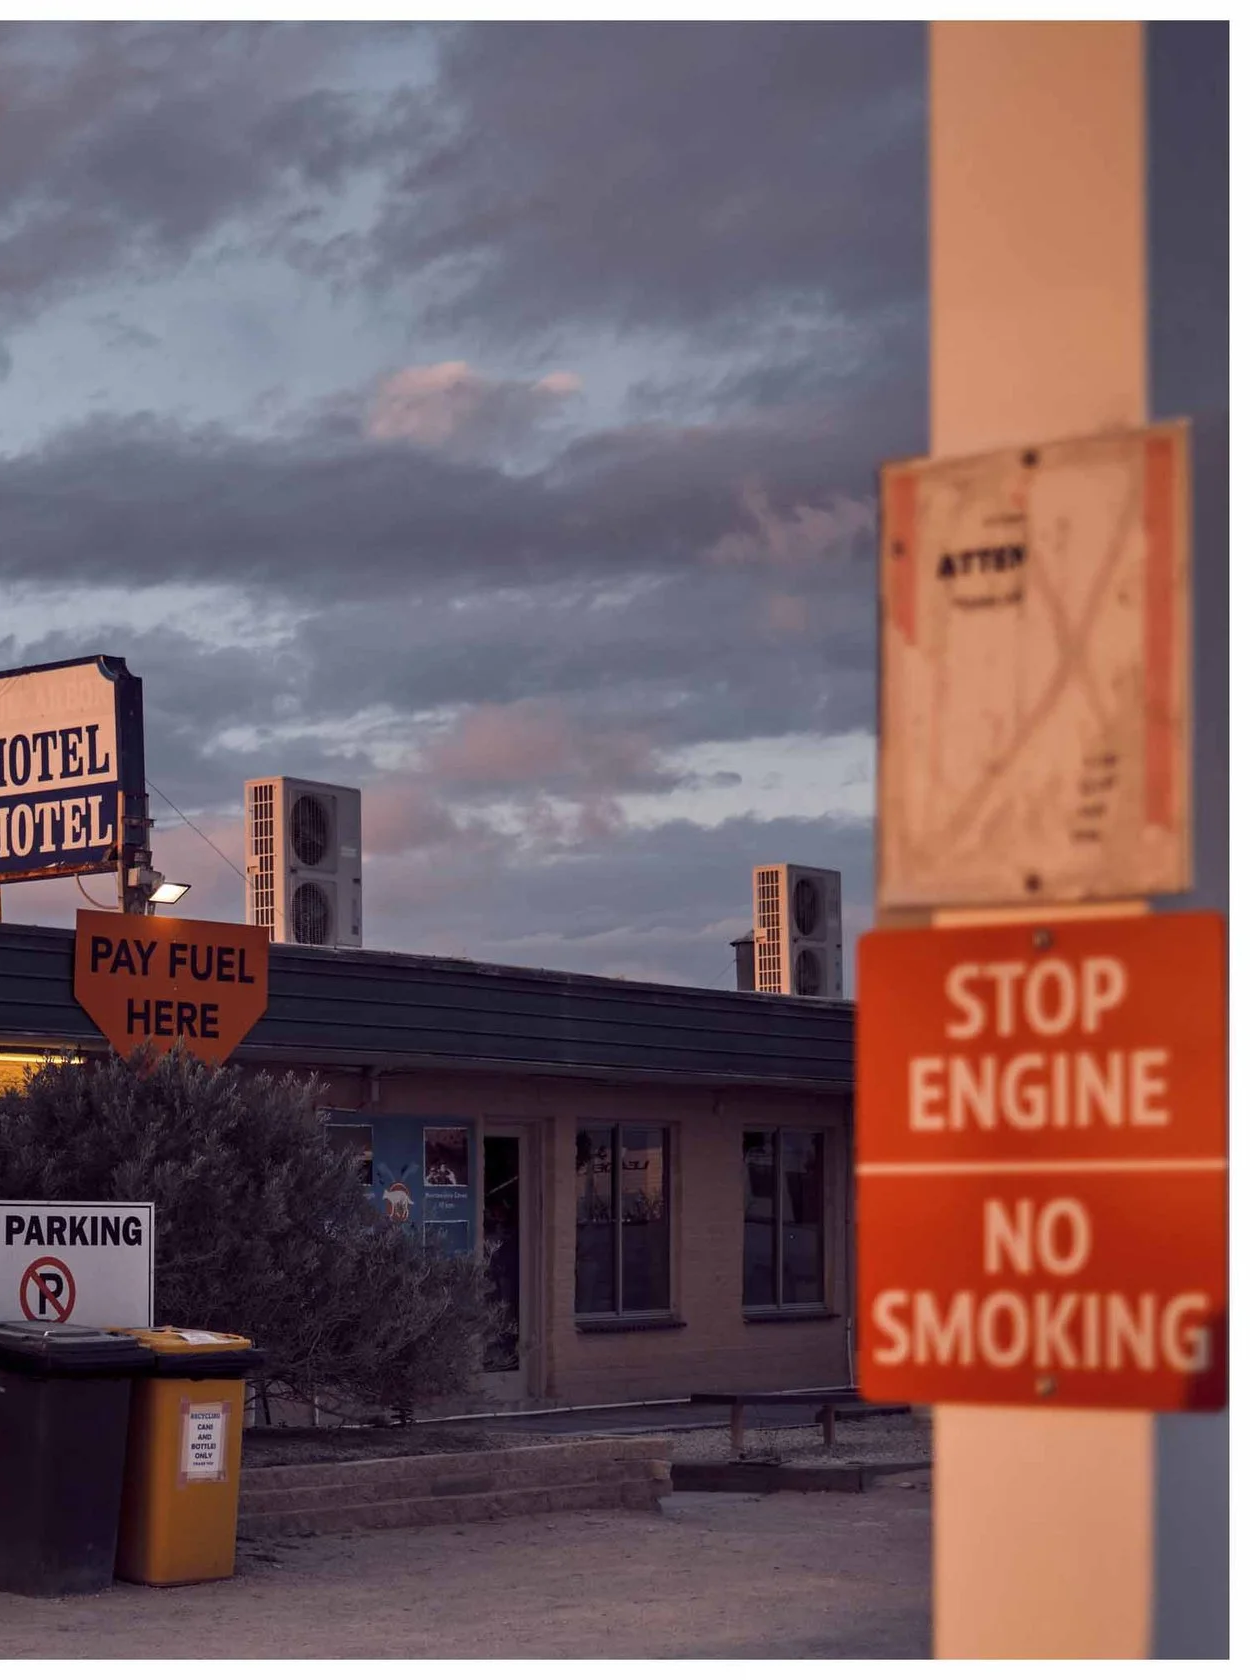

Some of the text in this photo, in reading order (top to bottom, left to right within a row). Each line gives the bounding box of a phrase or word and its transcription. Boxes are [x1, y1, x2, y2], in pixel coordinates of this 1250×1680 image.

[91, 935, 255, 984] PAY FUEL
[945, 957, 1127, 1040] STOP
[127, 998, 220, 1039] HERE
[908, 1048, 1170, 1132] ENGINE
[5, 1215, 143, 1247] PARKING
[983, 1197, 1092, 1277] NO
[872, 1288, 1211, 1373] SMOKING
